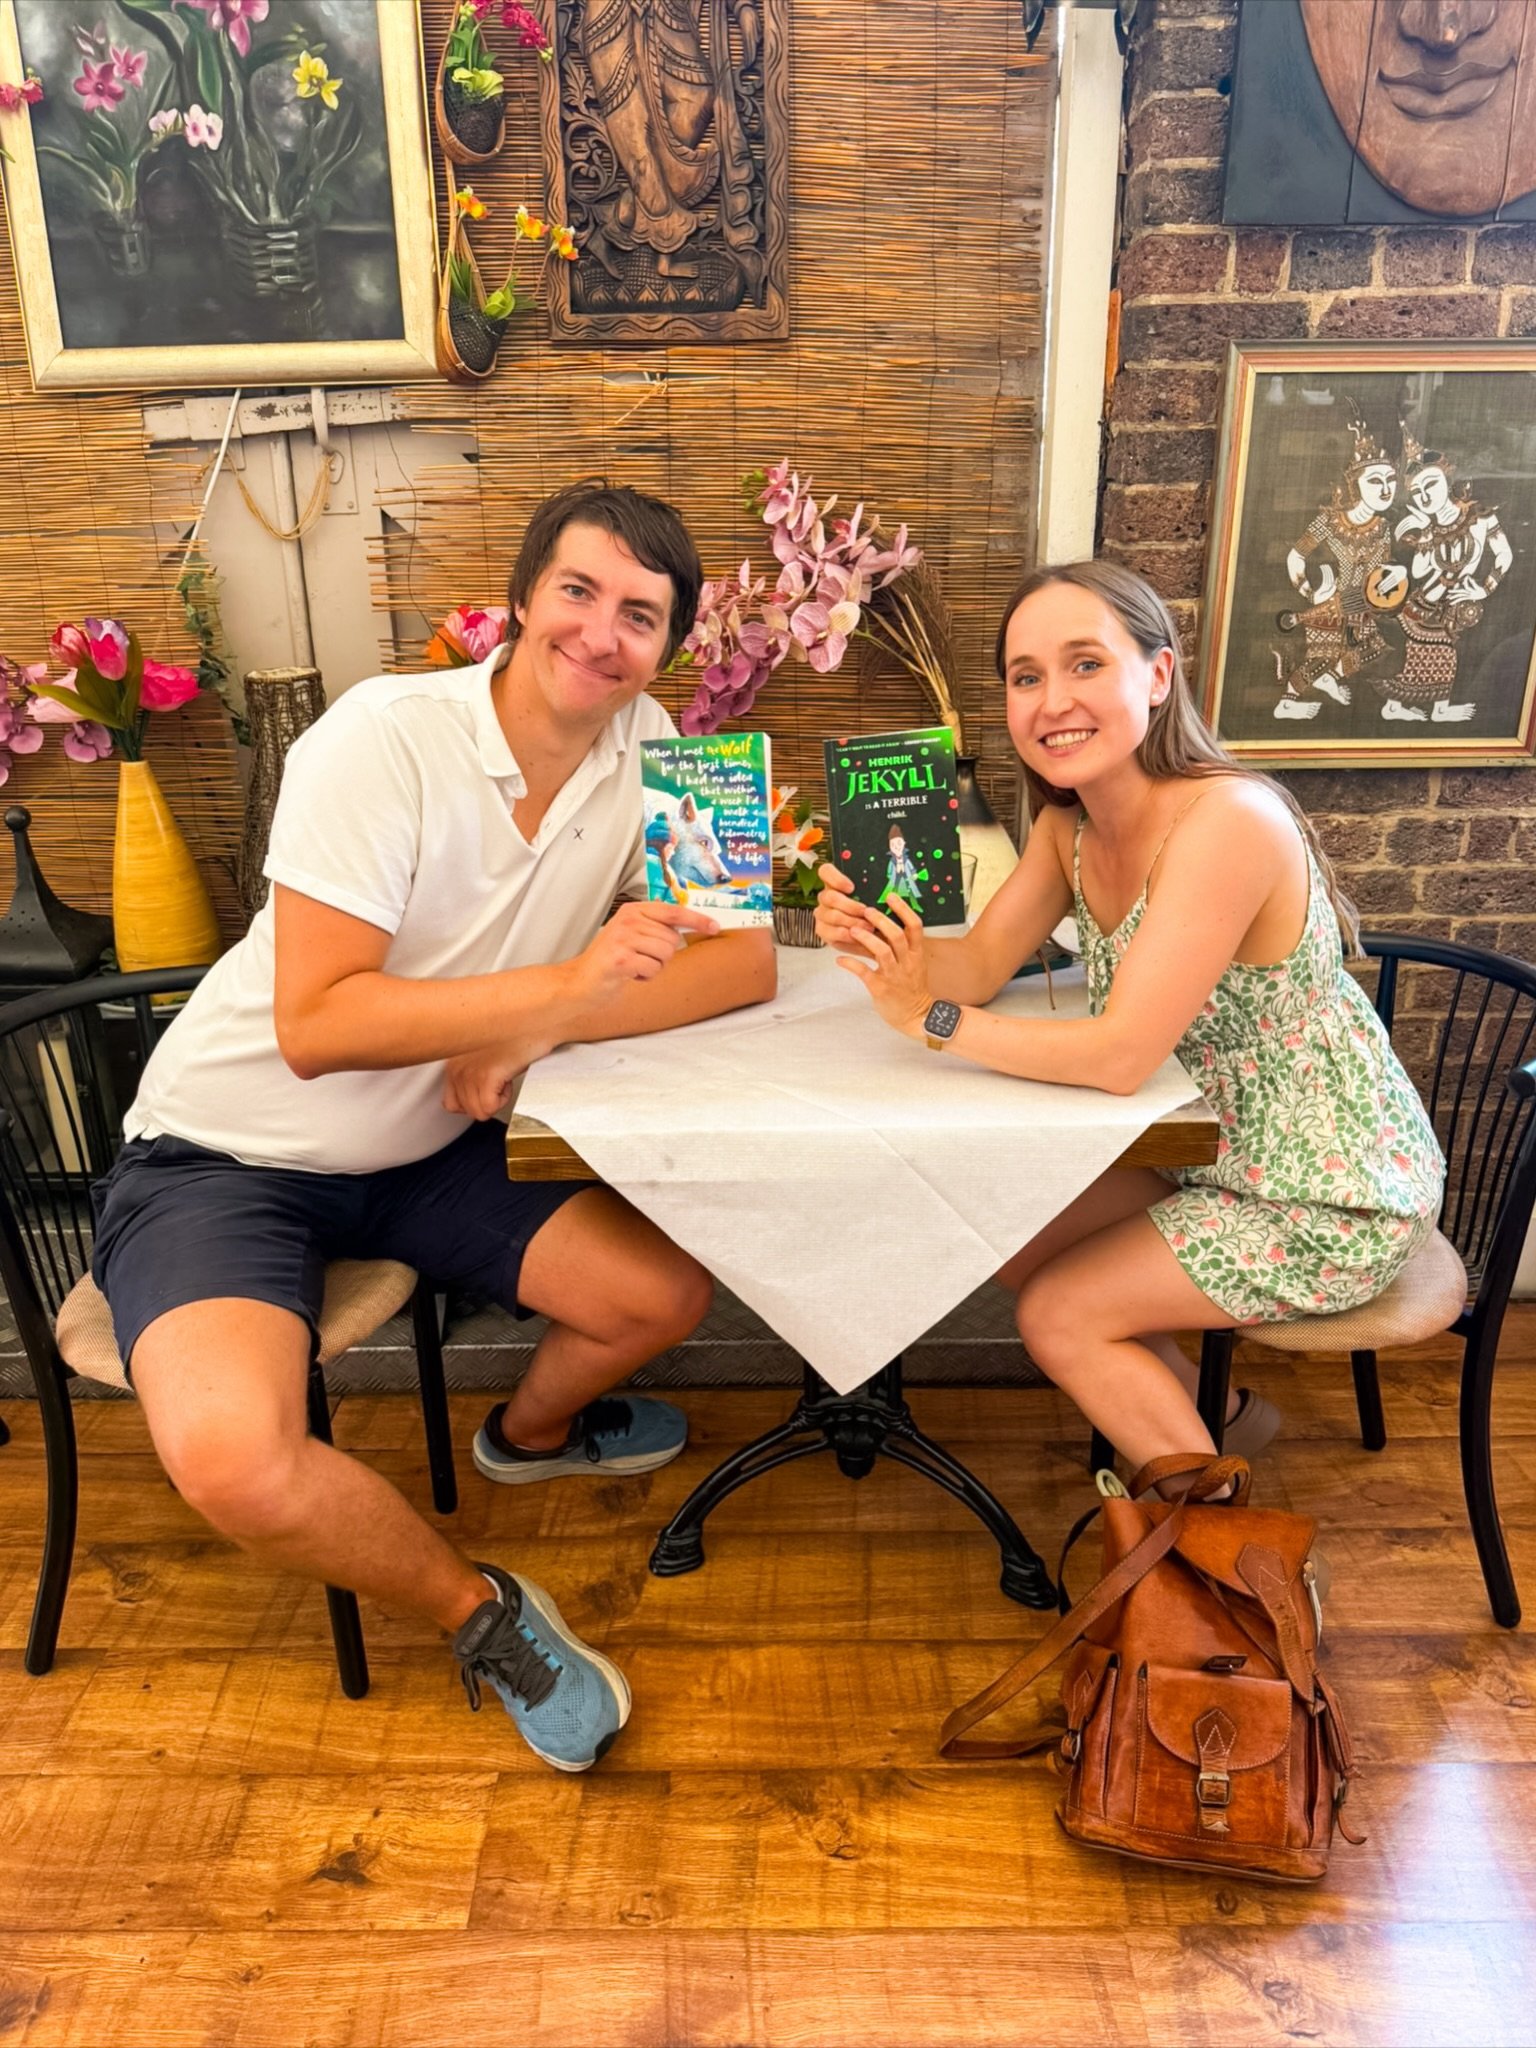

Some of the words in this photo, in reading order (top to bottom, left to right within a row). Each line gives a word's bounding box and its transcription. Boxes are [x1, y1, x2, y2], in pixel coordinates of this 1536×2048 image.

[644, 748, 672, 759] When
[675, 745, 680, 757] I
[683, 745, 704, 755] met
[720, 734, 753, 757] Wolf
[661, 761, 674, 777] for
[679, 760, 695, 771] the
[697, 759, 719, 774] first
[868, 754, 914, 768] HENRIK
[676, 774, 681, 787] I
[686, 773, 707, 785] had
[712, 775, 725, 783] no
[729, 771, 753, 783] idea
[839, 763, 947, 806] JEKYLL
[700, 785, 720, 796] that
[724, 784, 757, 795] within
[873, 801, 880, 809] A
[880, 795, 928, 808] TERRIBLE
[728, 839, 735, 849] to
